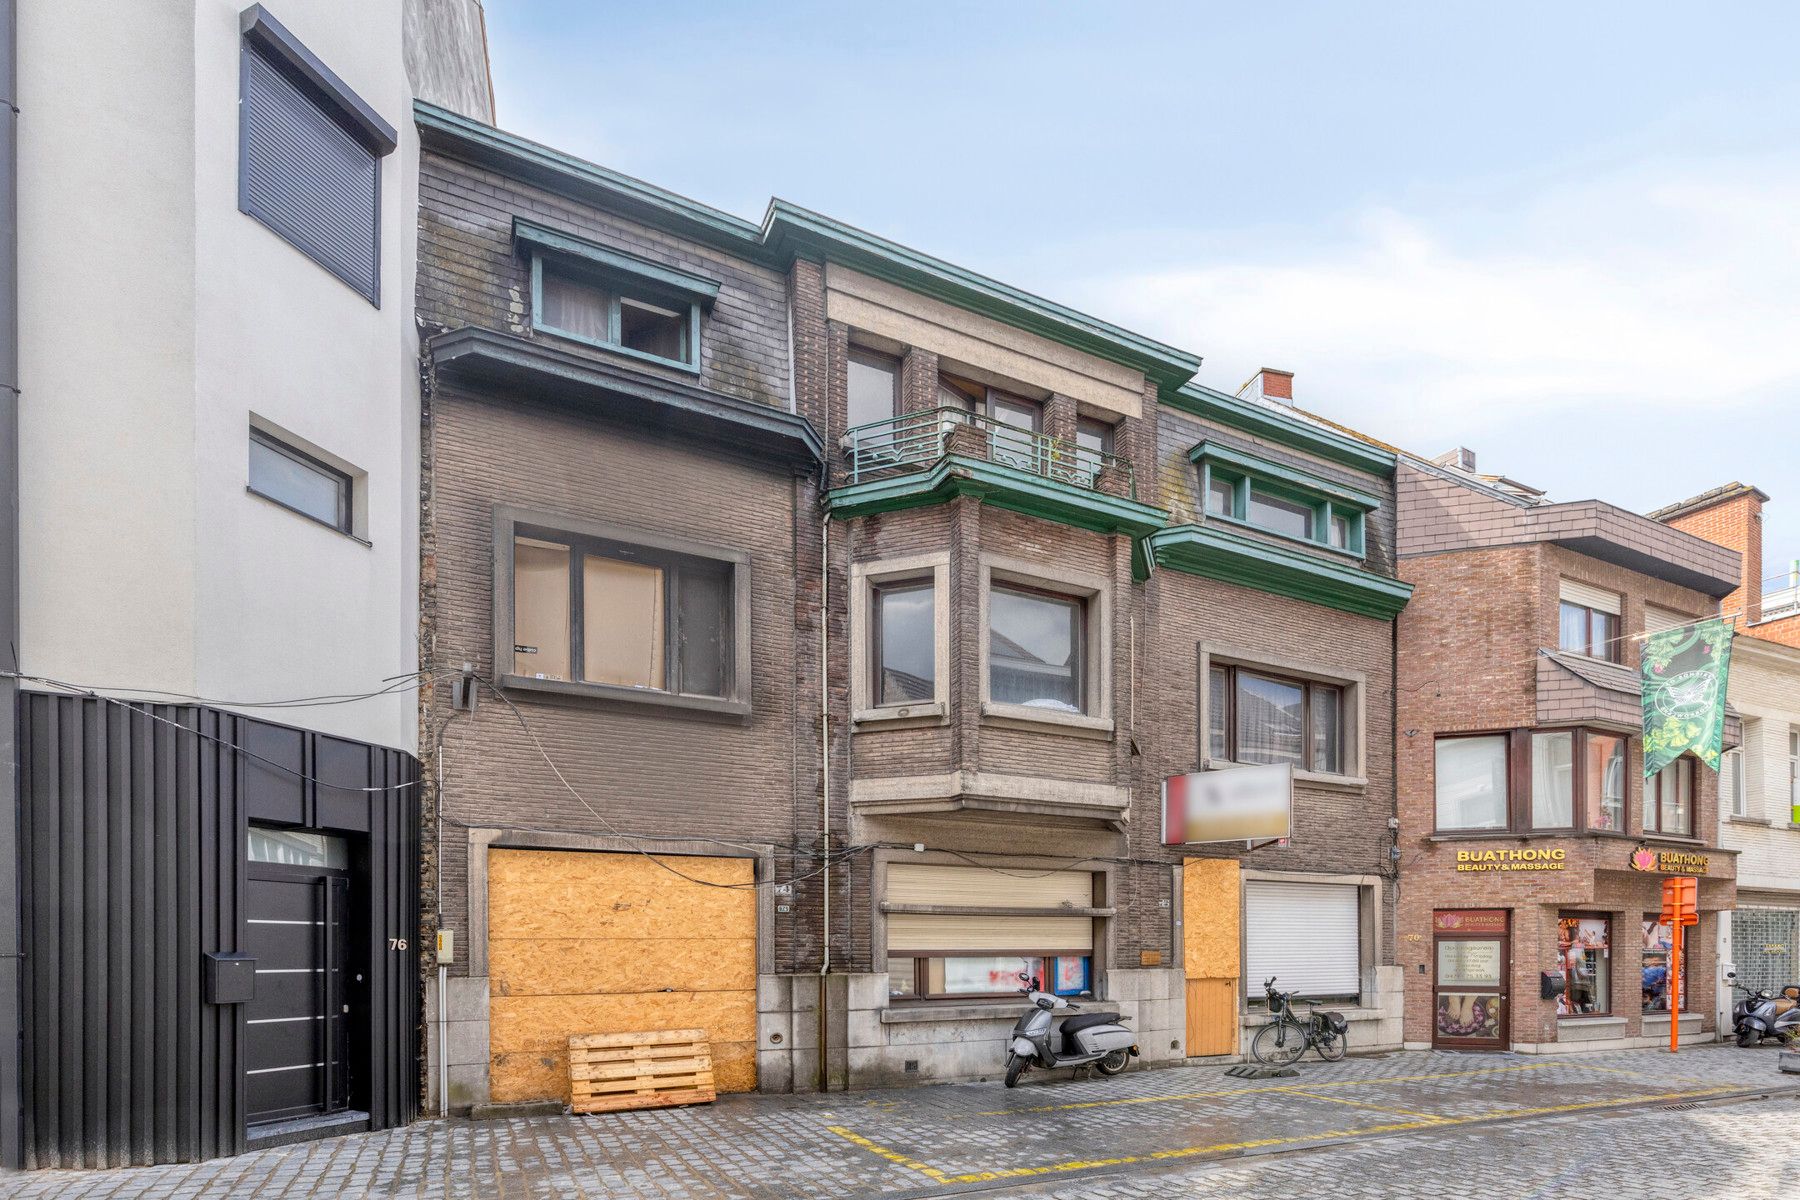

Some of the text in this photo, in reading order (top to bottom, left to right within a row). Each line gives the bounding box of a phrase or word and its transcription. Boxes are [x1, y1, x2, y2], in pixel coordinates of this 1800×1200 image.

[1457, 849, 1566, 862] BUATHONG
[1660, 852, 1710, 866] BUATHONG
[1511, 862, 1565, 870] MASSAGE
[1660, 864, 1681, 872] BEAUTY
[388, 938, 407, 951] 76
